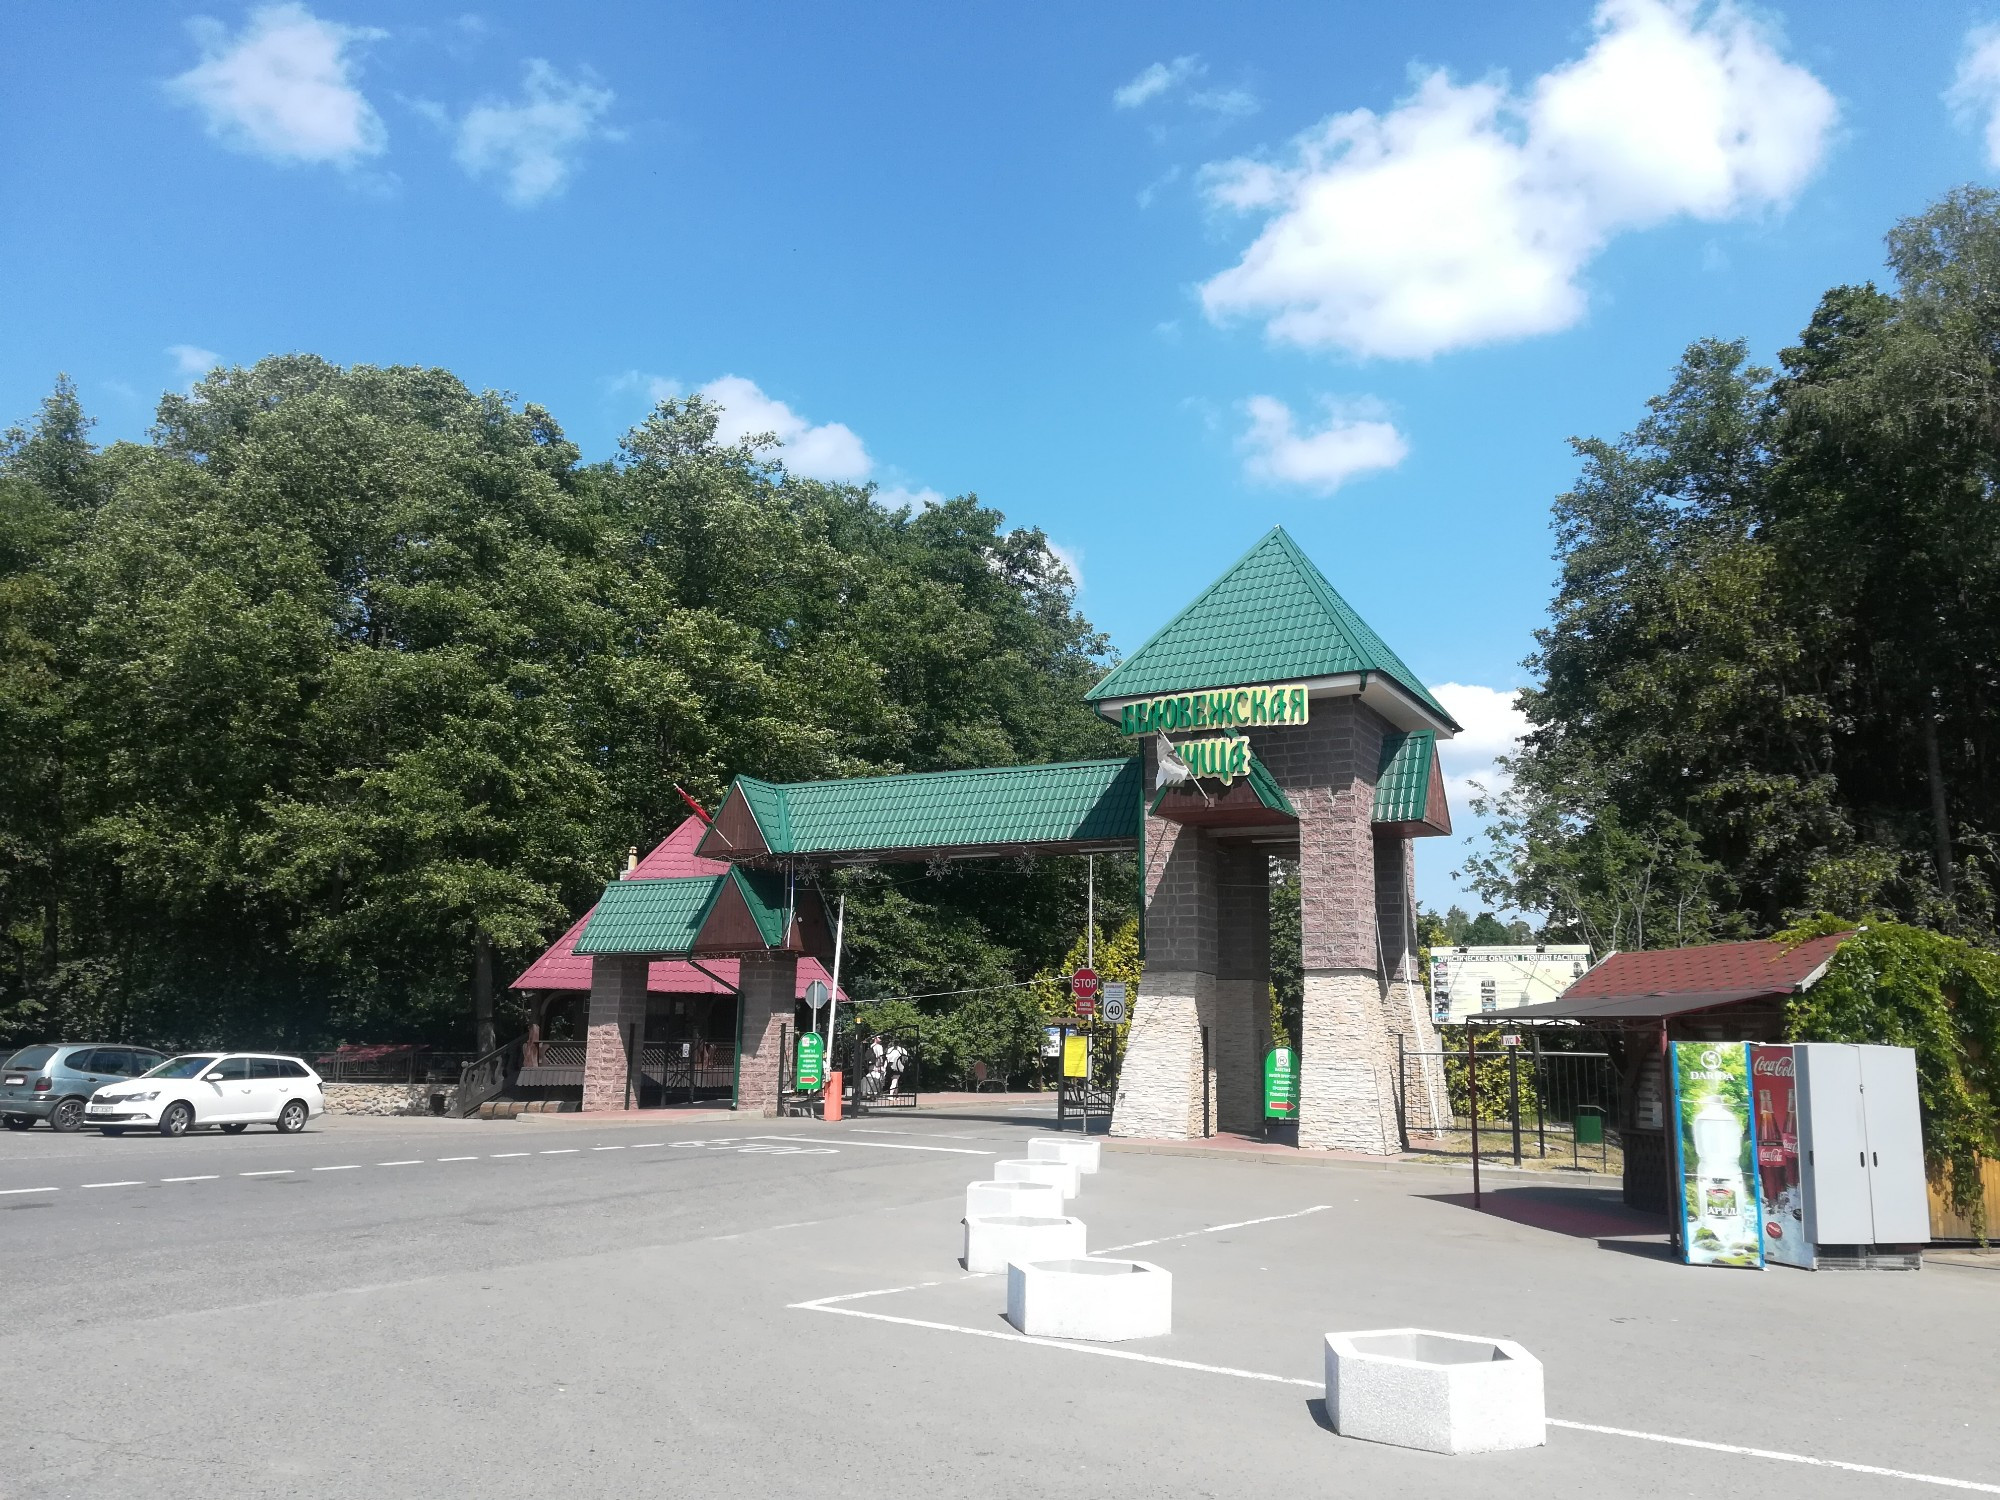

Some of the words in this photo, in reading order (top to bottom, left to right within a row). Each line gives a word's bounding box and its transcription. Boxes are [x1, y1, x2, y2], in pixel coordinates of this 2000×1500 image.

[1121, 687, 1305, 737] БЕЛОВЕЖСКАЯ
[1074, 979, 1097, 988] STOP
[1108, 1005, 1120, 1015] 40
